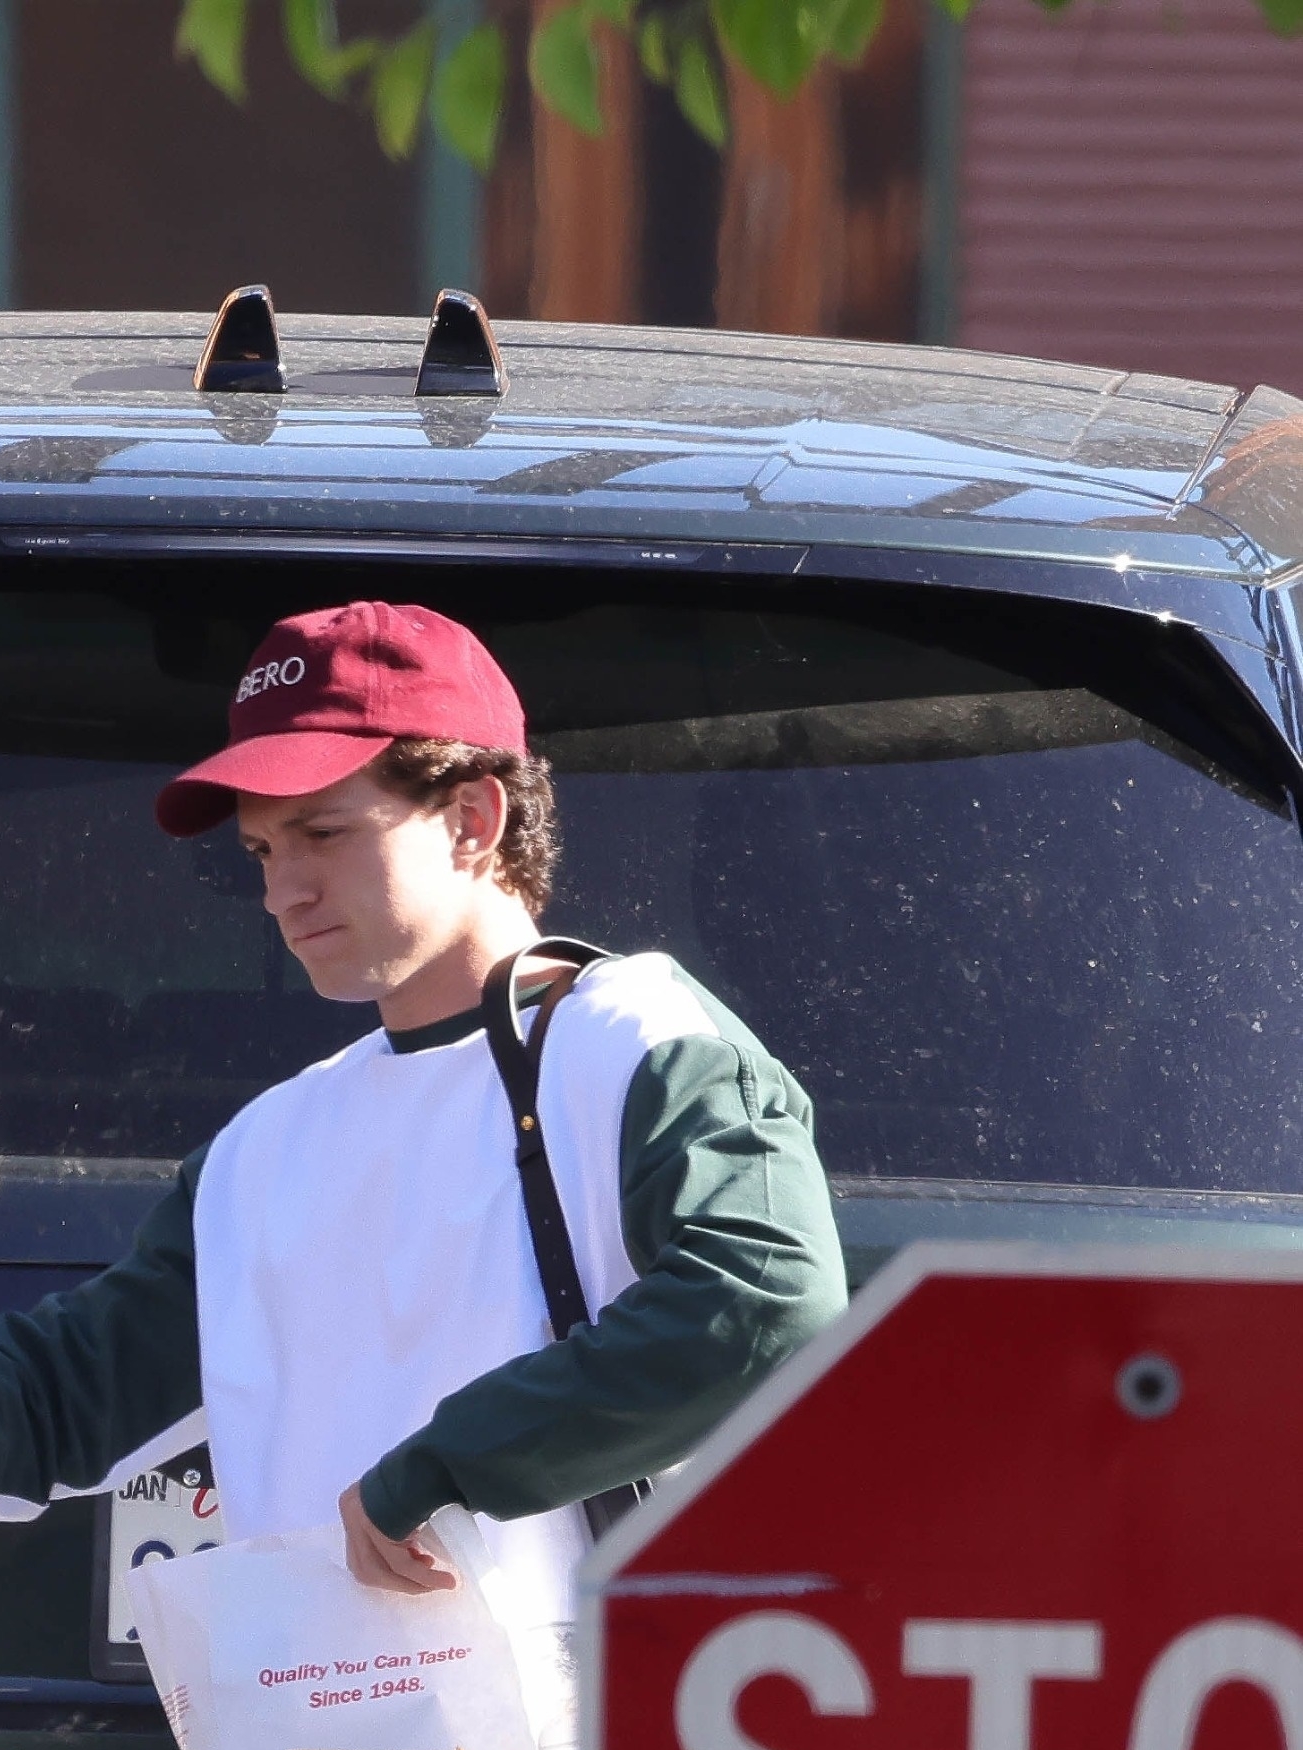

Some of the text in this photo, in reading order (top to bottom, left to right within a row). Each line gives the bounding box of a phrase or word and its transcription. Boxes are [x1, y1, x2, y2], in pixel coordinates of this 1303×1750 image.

[236, 657, 305, 703] BERO
[119, 1474, 168, 1502] JAN
[258, 1664, 328, 1686] Quality
[334, 1660, 367, 1675] You
[374, 1655, 411, 1670] Can
[309, 1676, 425, 1708] Since 1948.
